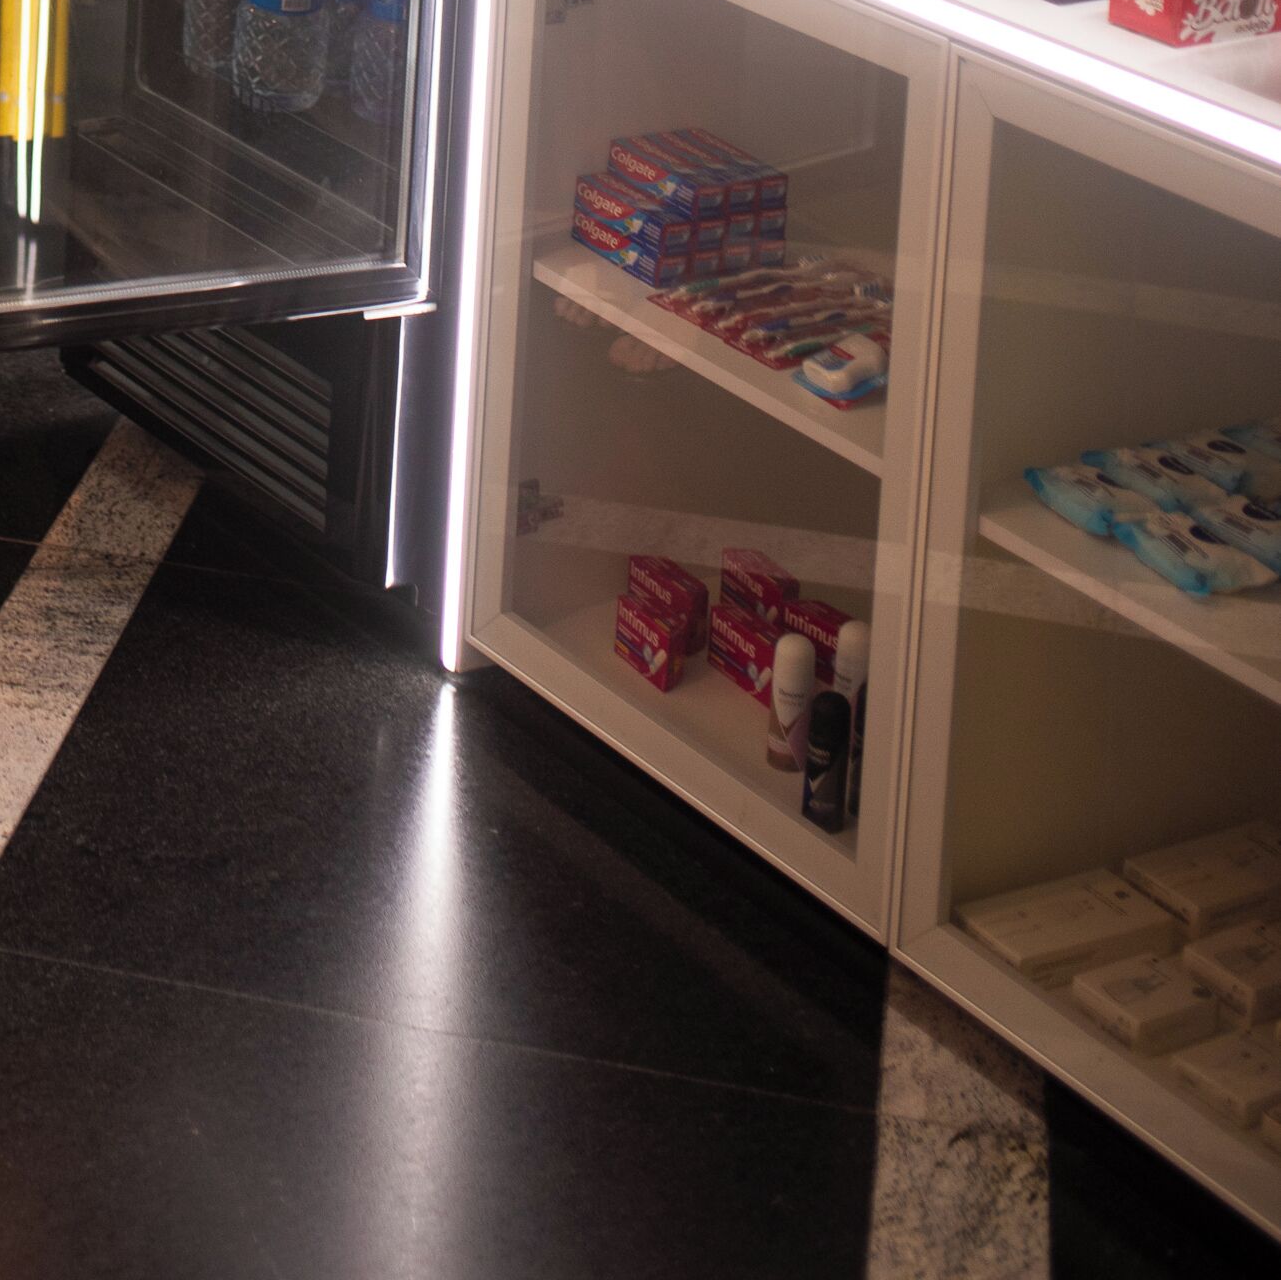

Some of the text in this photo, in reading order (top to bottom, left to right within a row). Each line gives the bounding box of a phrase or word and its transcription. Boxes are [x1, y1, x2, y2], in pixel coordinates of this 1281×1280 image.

[610, 145, 657, 182] Colgate
[577, 181, 624, 217] Colgate
[574, 213, 619, 249] Colgate
[630, 560, 672, 606] Intimus
[618, 600, 660, 648] Intimus
[712, 612, 757, 660] Intimus
